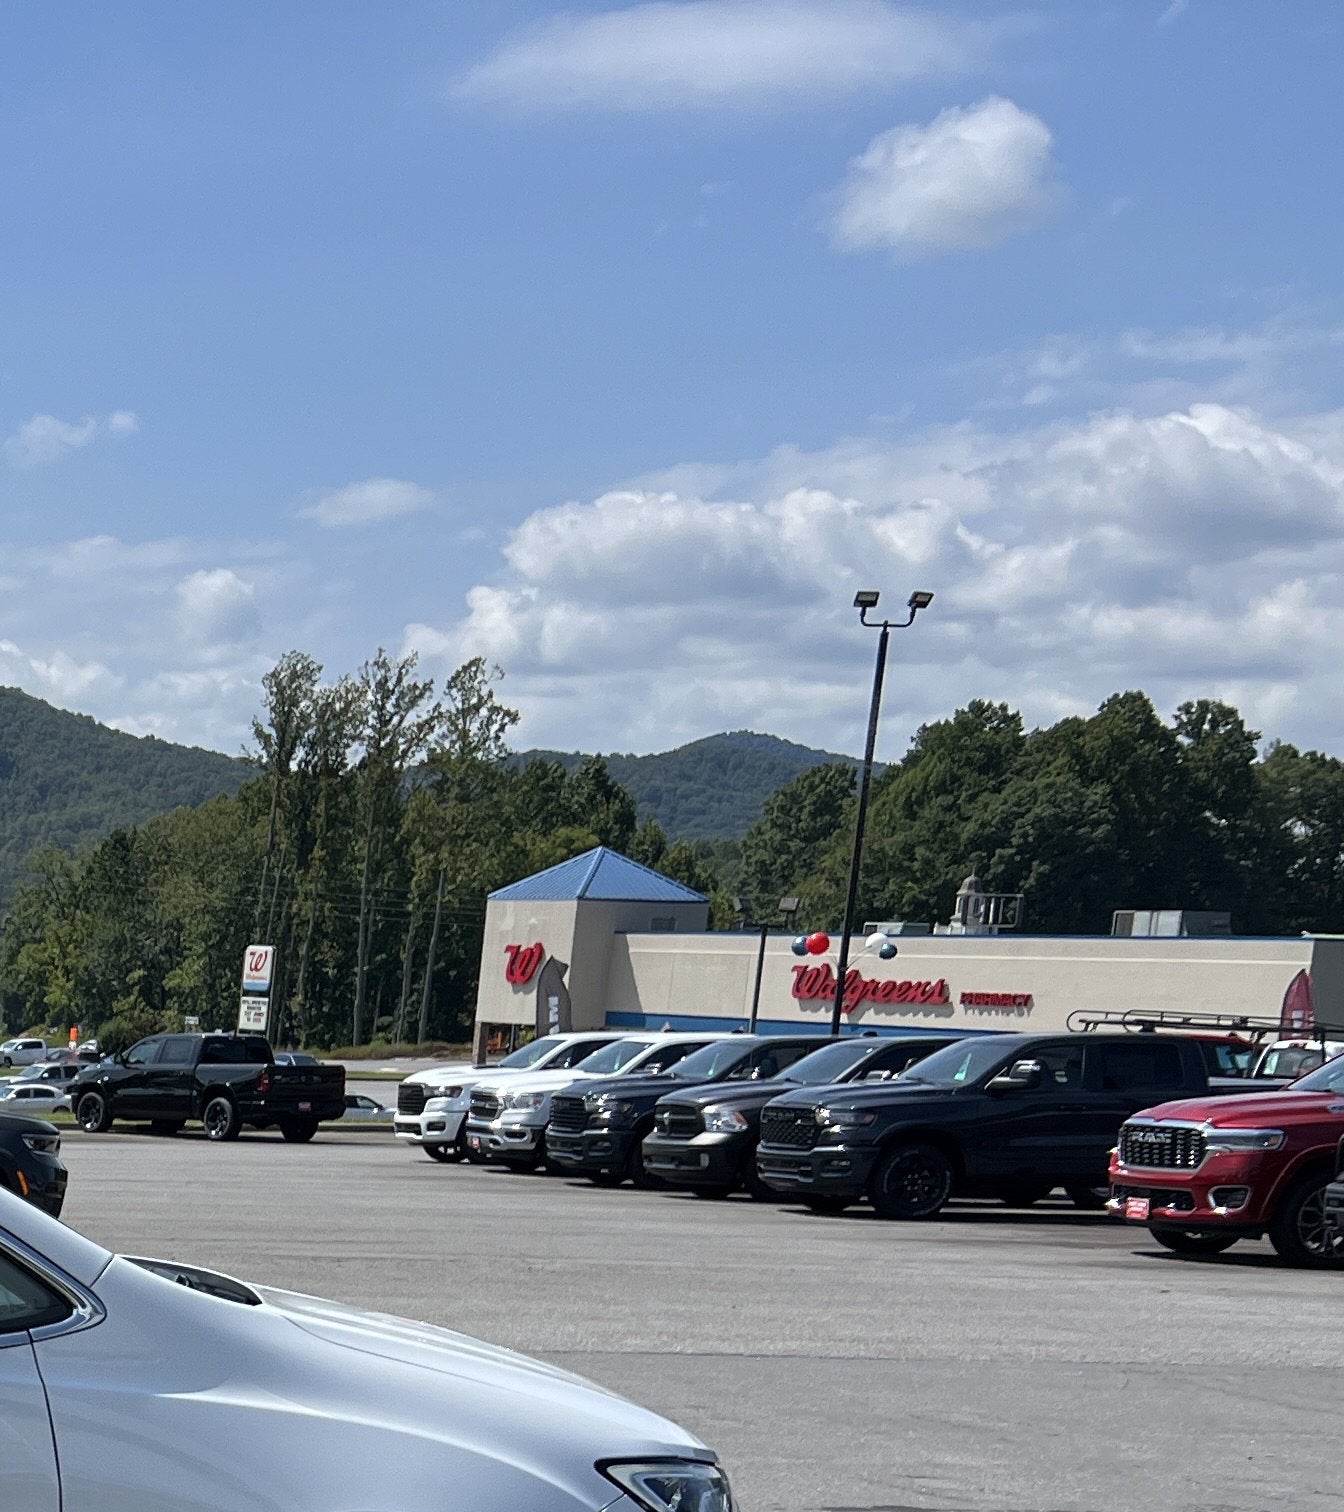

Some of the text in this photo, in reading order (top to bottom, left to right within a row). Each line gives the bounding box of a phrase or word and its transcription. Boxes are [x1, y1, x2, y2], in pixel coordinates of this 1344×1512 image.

[249, 950, 268, 972] W
[504, 942, 544, 985] W
[791, 963, 950, 1014] Walgreens
